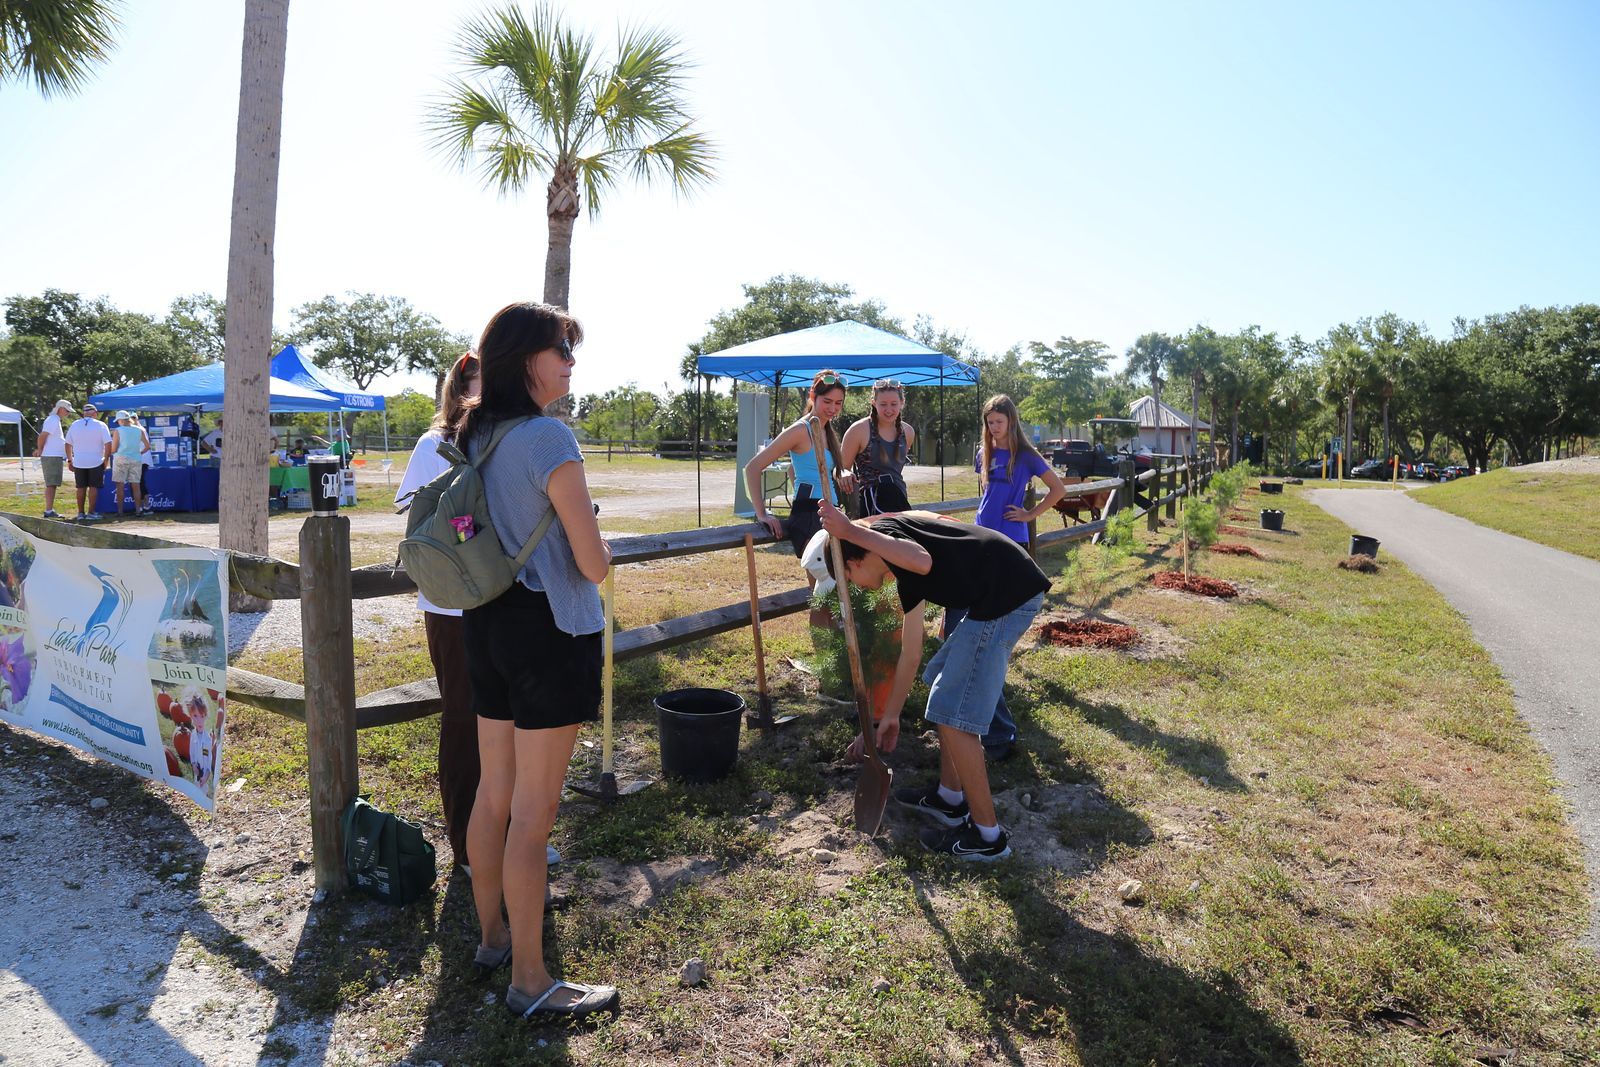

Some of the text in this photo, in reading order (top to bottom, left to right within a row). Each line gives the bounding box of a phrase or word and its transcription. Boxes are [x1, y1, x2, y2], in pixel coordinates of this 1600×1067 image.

[0, 609, 12, 621] in
[86, 623, 127, 675] Park
[163, 663, 216, 684] Join Us!
